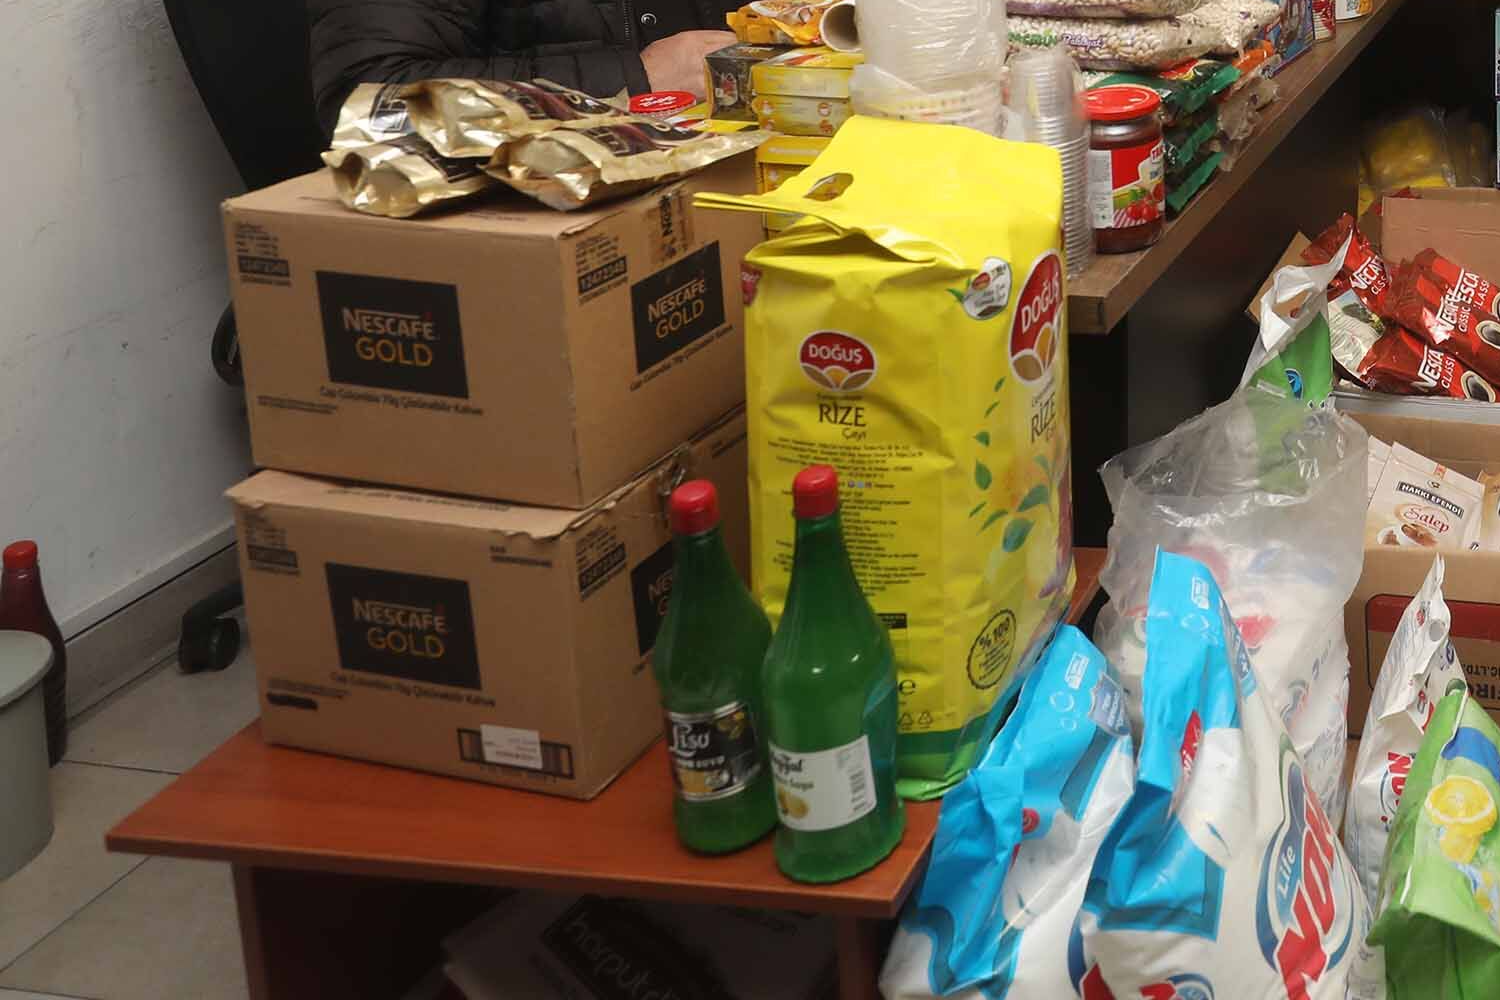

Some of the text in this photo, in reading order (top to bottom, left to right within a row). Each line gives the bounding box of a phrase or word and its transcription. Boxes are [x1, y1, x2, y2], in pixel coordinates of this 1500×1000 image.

[1021, 274, 1060, 333] DOĞUŞ
[655, 298, 705, 340] GOLD
[356, 335, 434, 368] GOLD
[808, 342, 864, 365] DOĞUŞ
[818, 403, 867, 427] RİZE
[1401, 483, 1431, 500] HAKKI
[1403, 506, 1450, 534] Salep
[366, 626, 446, 660] GOLD
